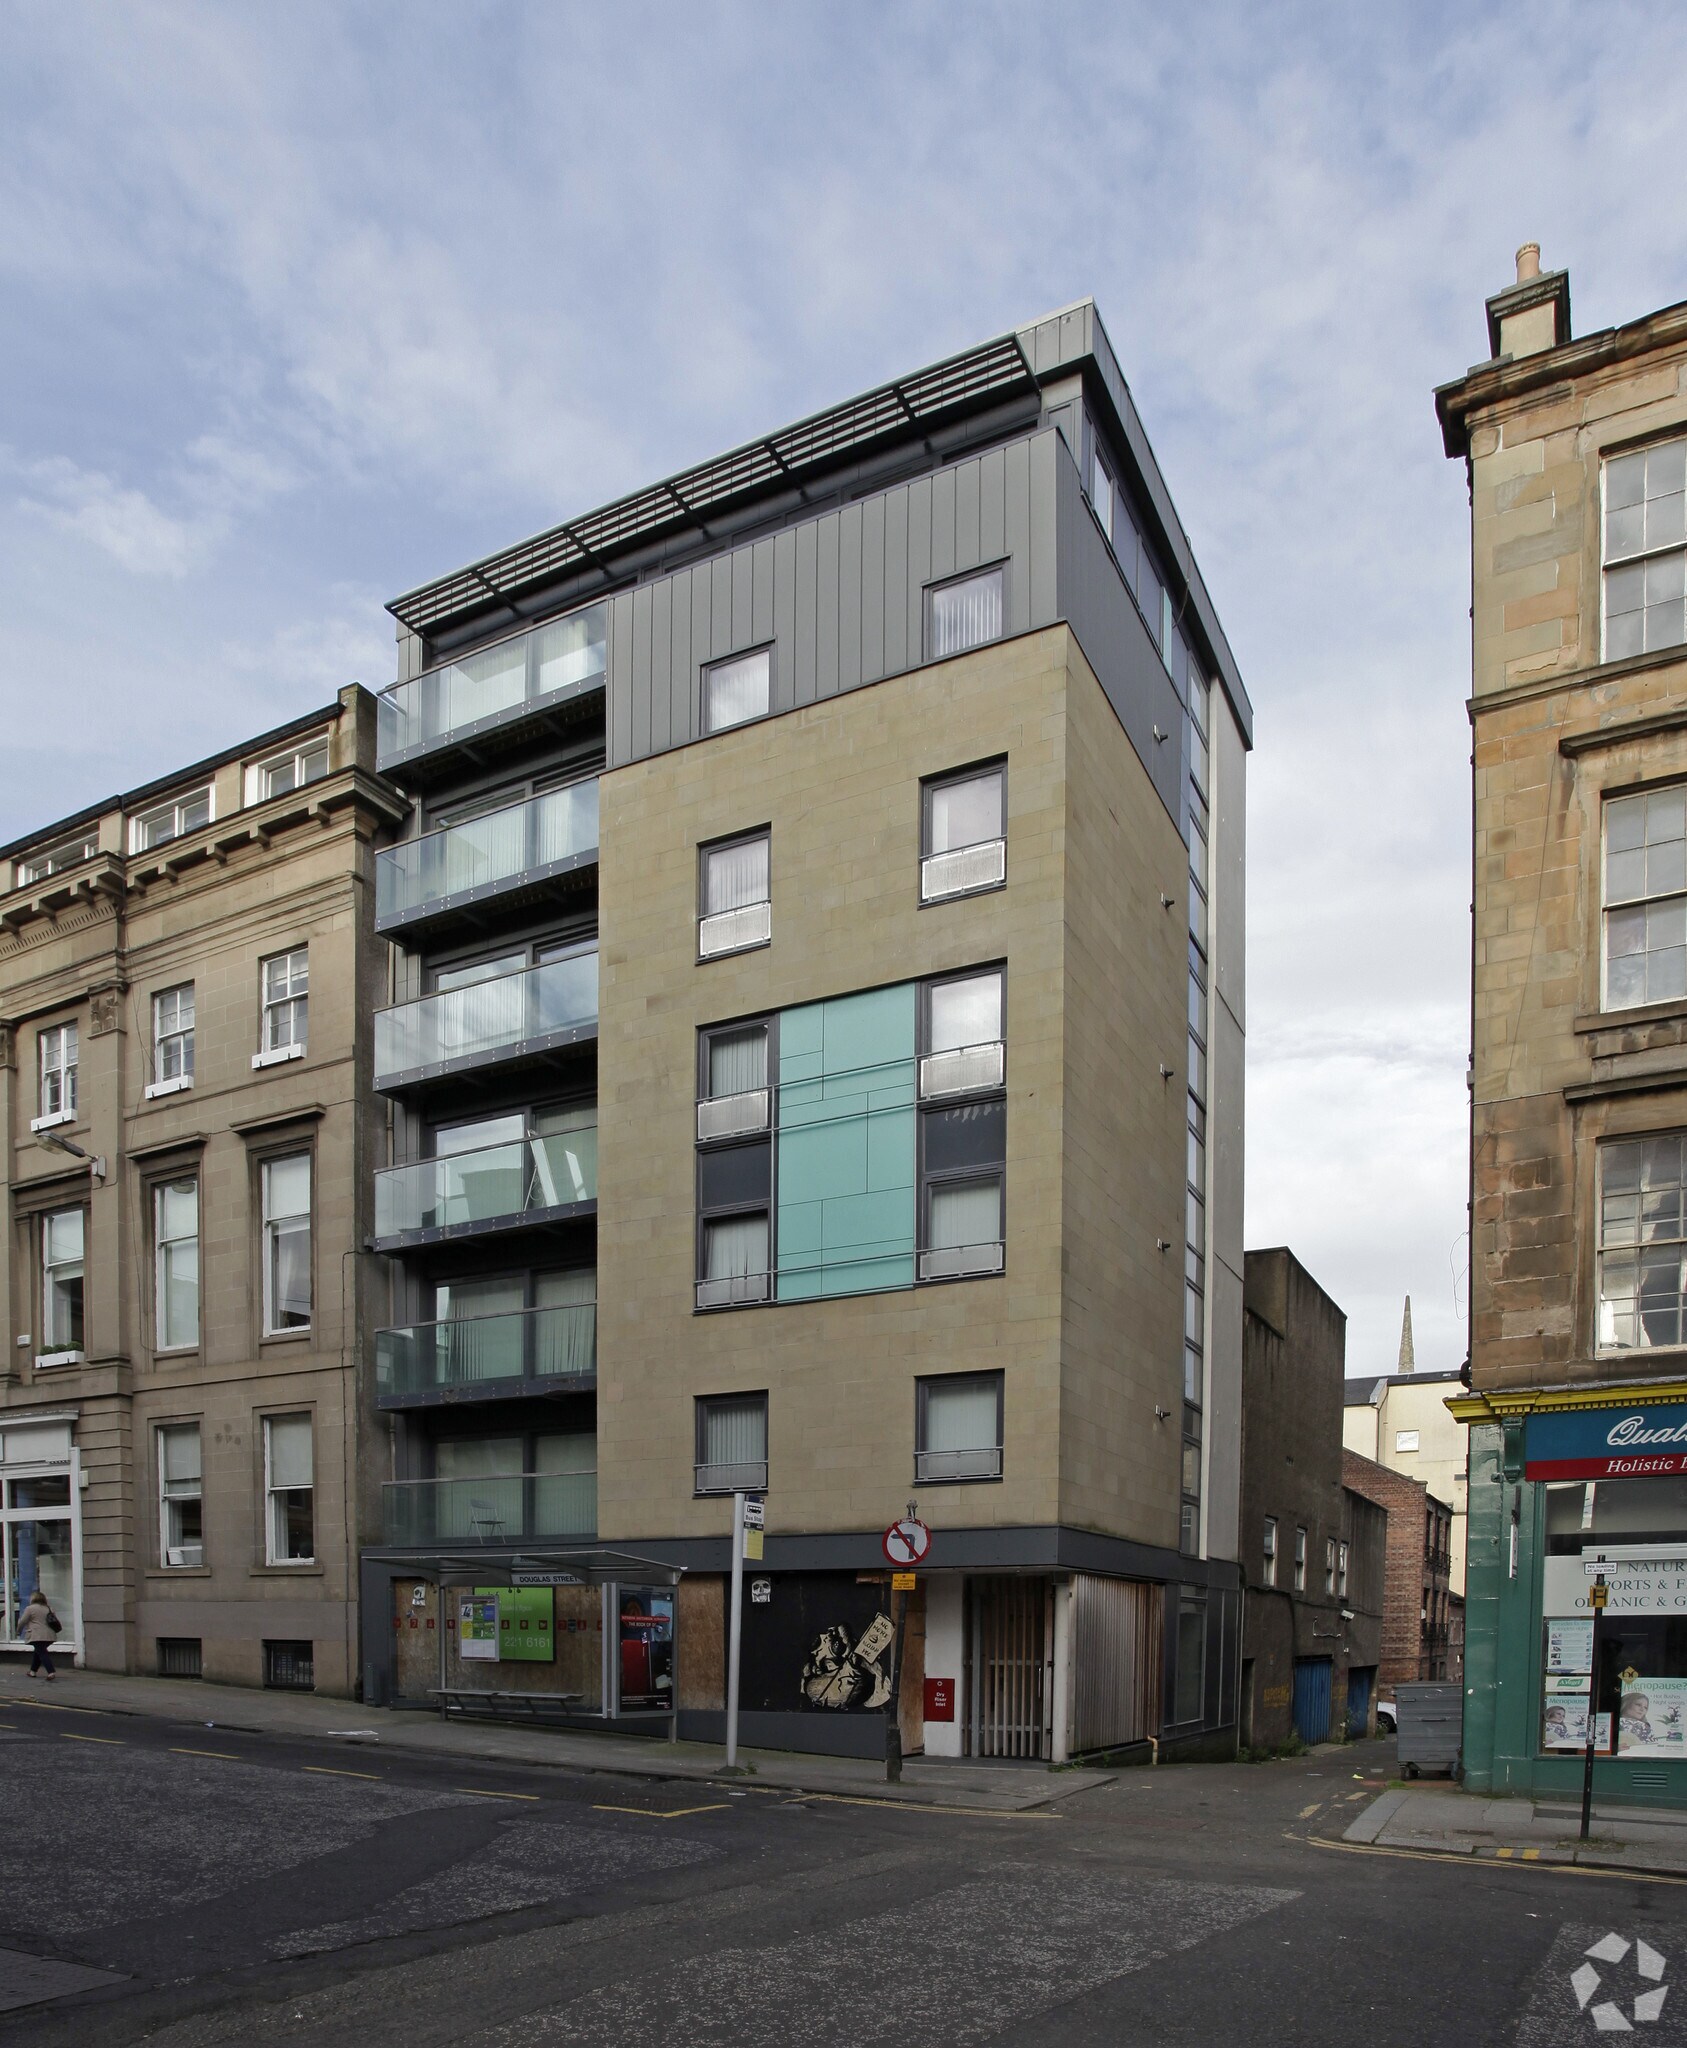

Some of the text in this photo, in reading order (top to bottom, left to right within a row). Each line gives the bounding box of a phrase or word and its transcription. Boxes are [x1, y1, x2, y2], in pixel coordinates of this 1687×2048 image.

[1606, 1457, 1674, 1473] Holistic
[1628, 1561, 1686, 1573] NATUR
[519, 1575, 551, 1583] DOUGLAS
[1657, 1579, 1668, 1590] &
[1656, 1596, 1667, 1607] &
[504, 1637, 550, 1648] 221 6161
[1624, 1681, 1687, 1691] Menopause?
